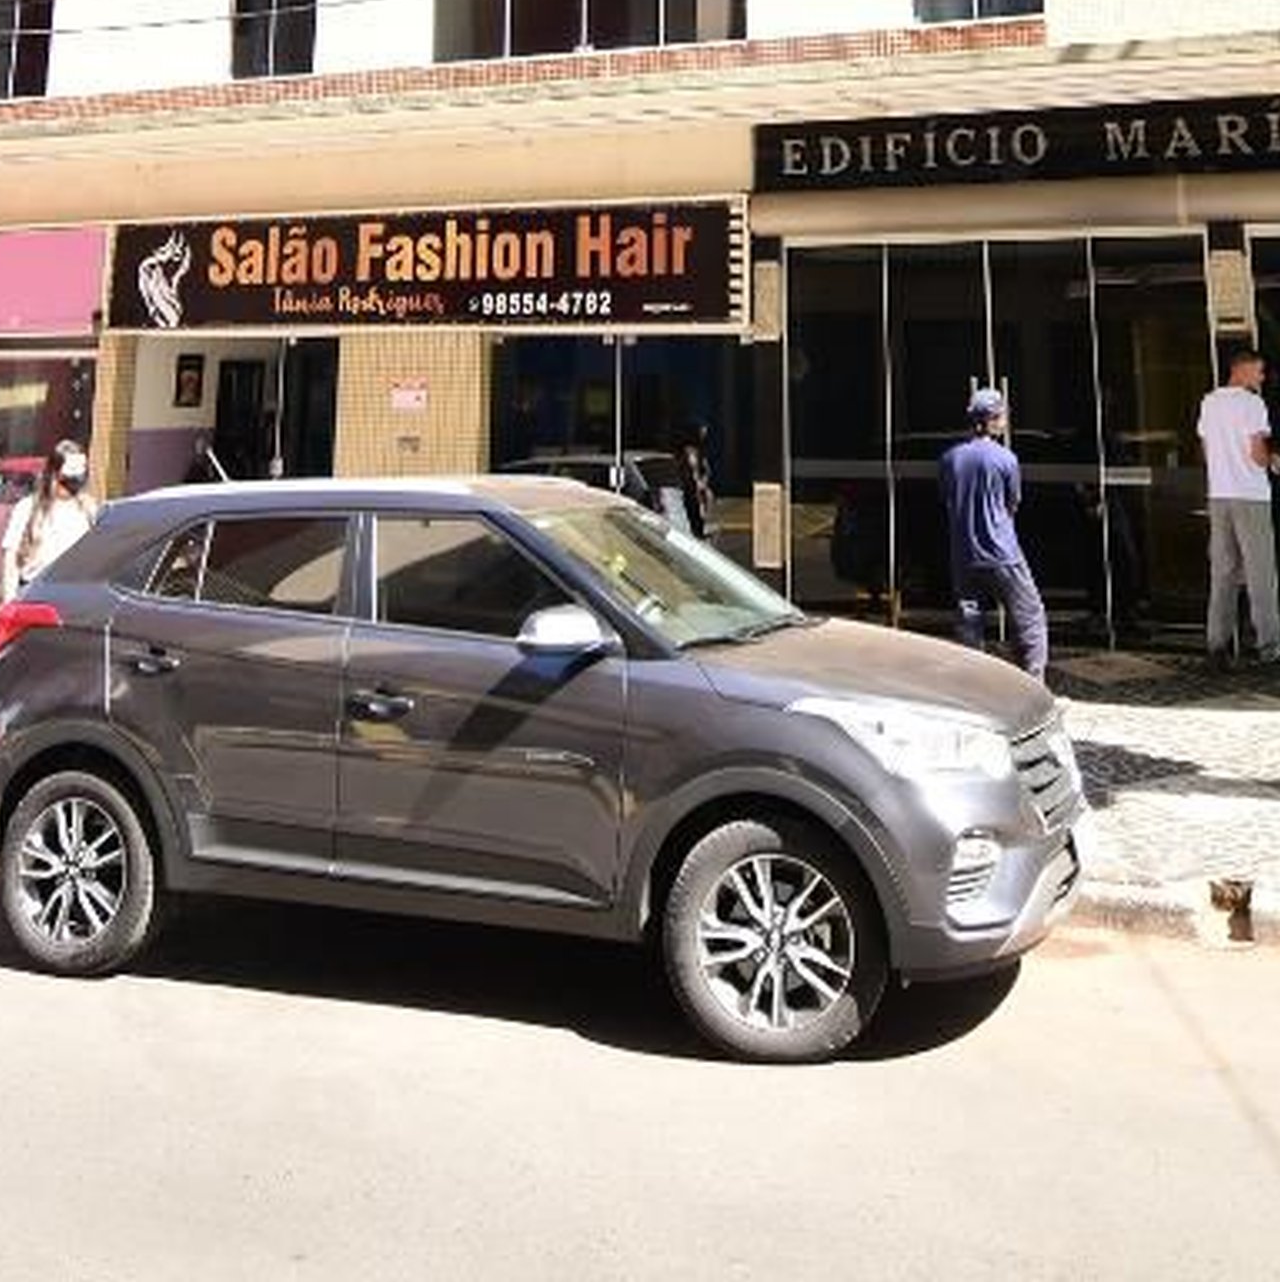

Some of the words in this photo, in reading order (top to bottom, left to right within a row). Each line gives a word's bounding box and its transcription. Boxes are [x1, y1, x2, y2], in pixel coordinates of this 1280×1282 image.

[782, 122, 1048, 176] EDIFÍCIO
[207, 224, 338, 287] Salão
[355, 218, 554, 282] Fashion
[576, 212, 693, 278] Hair
